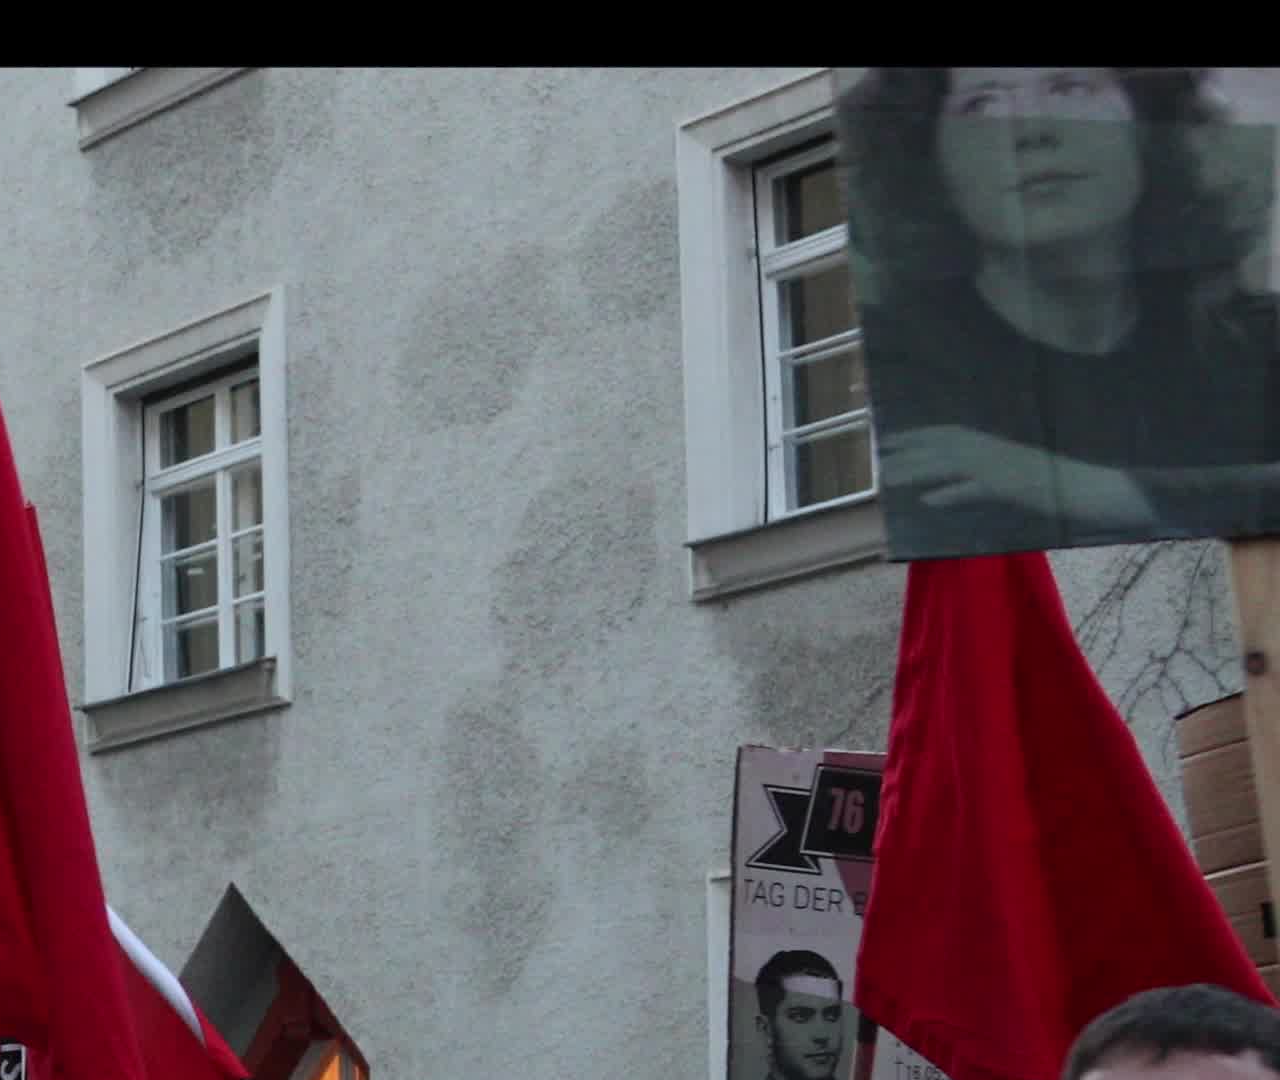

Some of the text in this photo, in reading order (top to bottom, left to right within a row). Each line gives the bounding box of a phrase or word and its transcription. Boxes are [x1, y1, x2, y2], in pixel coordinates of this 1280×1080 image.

[826, 788, 866, 835] 76
[743, 879, 786, 908] TAG
[793, 885, 845, 912] DER
